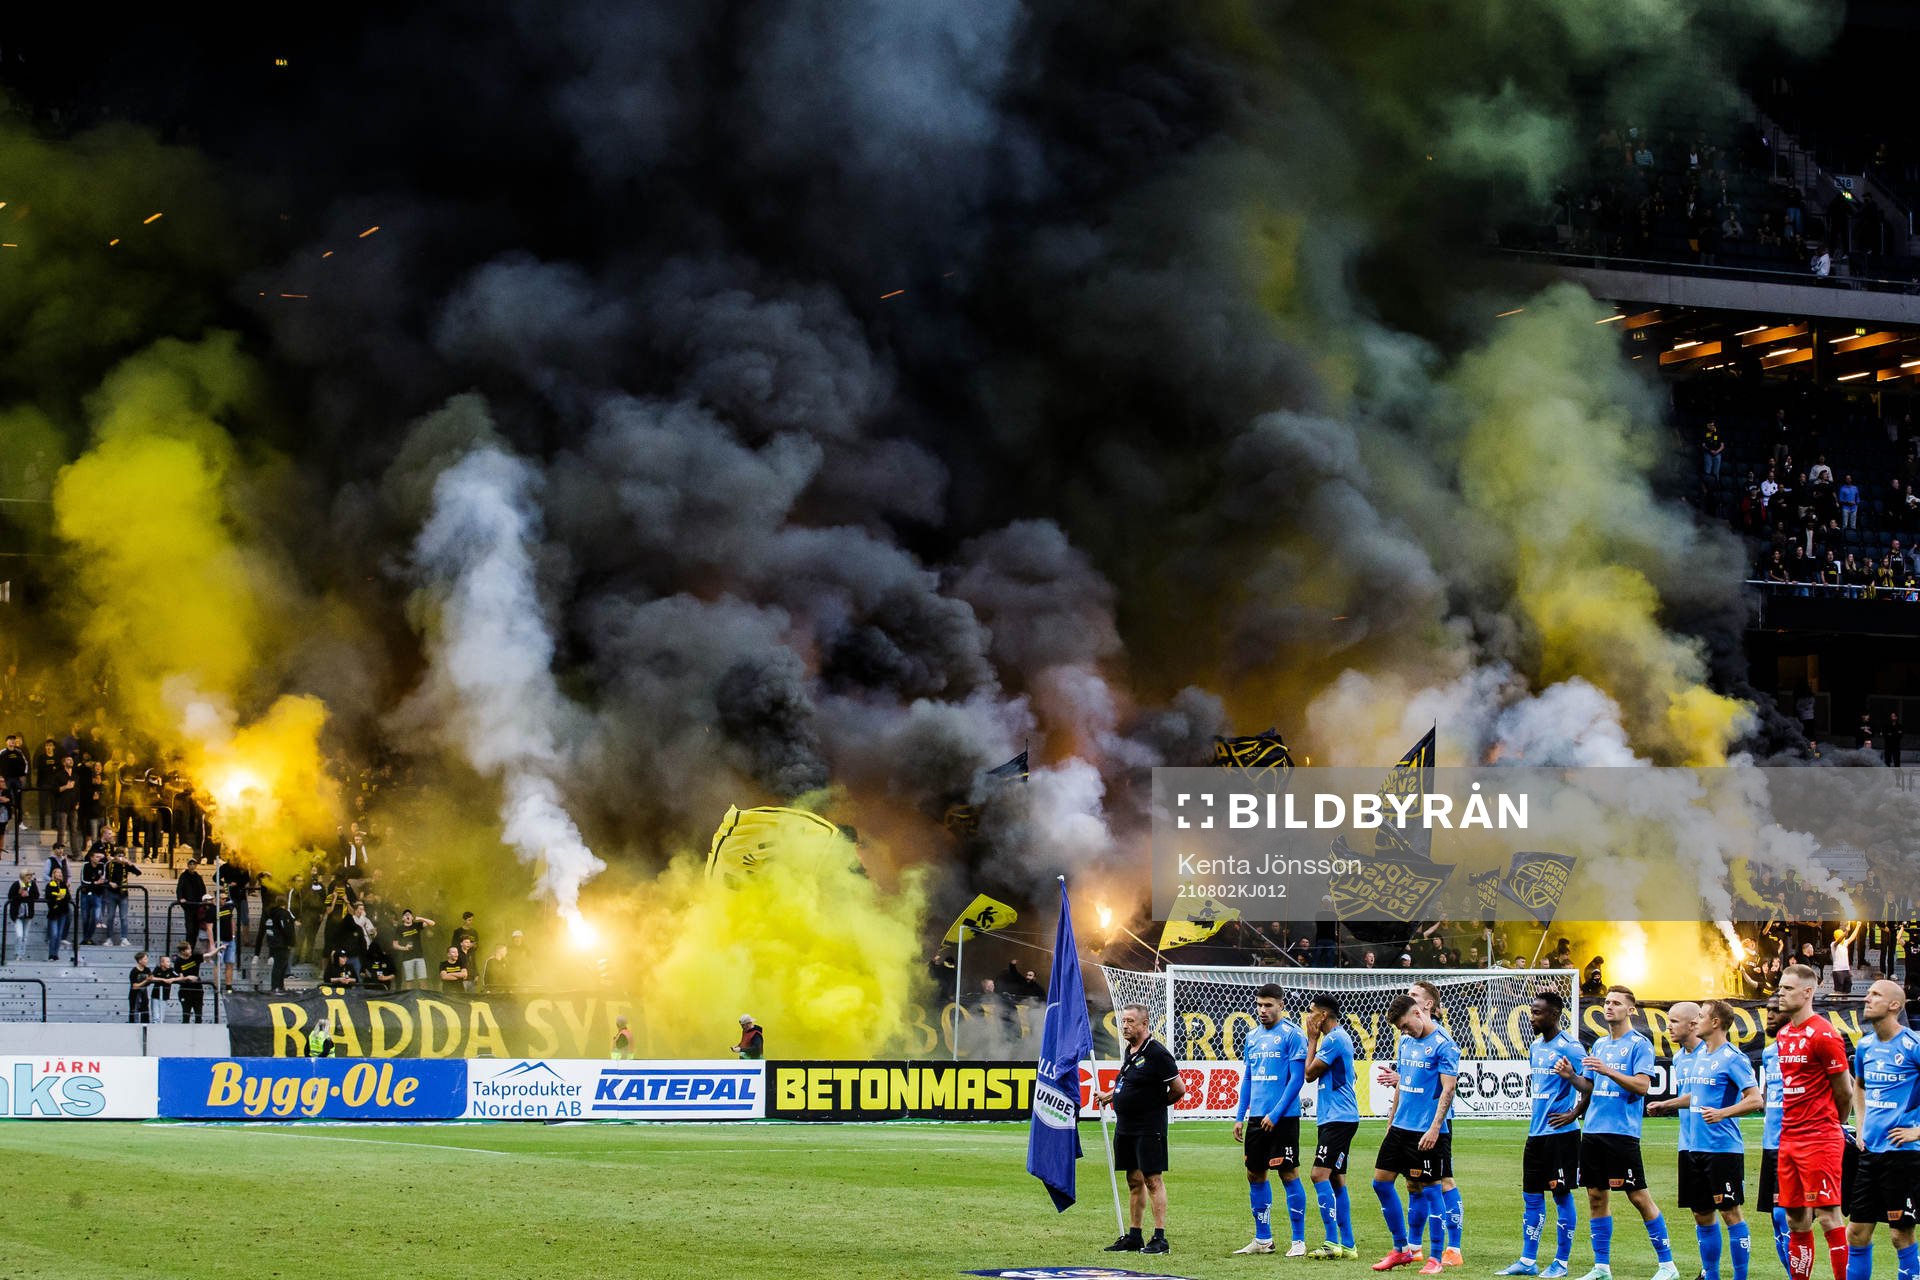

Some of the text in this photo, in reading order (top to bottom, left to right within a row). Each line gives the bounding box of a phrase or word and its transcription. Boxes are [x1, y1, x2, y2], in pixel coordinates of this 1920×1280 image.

[268, 985, 511, 1058] RÄDDA
[42, 1057, 101, 1074] JÄRN
[1400, 1058, 1431, 1069] ETINGE
[1864, 1071, 1907, 1082] ETINGE
[473, 1080, 582, 1099] Takprodukter
[594, 1078, 757, 1101] KATEPAL
[776, 1067, 1037, 1110] BETONMAST
[473, 1101, 582, 1117] Norden AB
[1473, 1101, 1531, 1111] SAINT-GOBA
